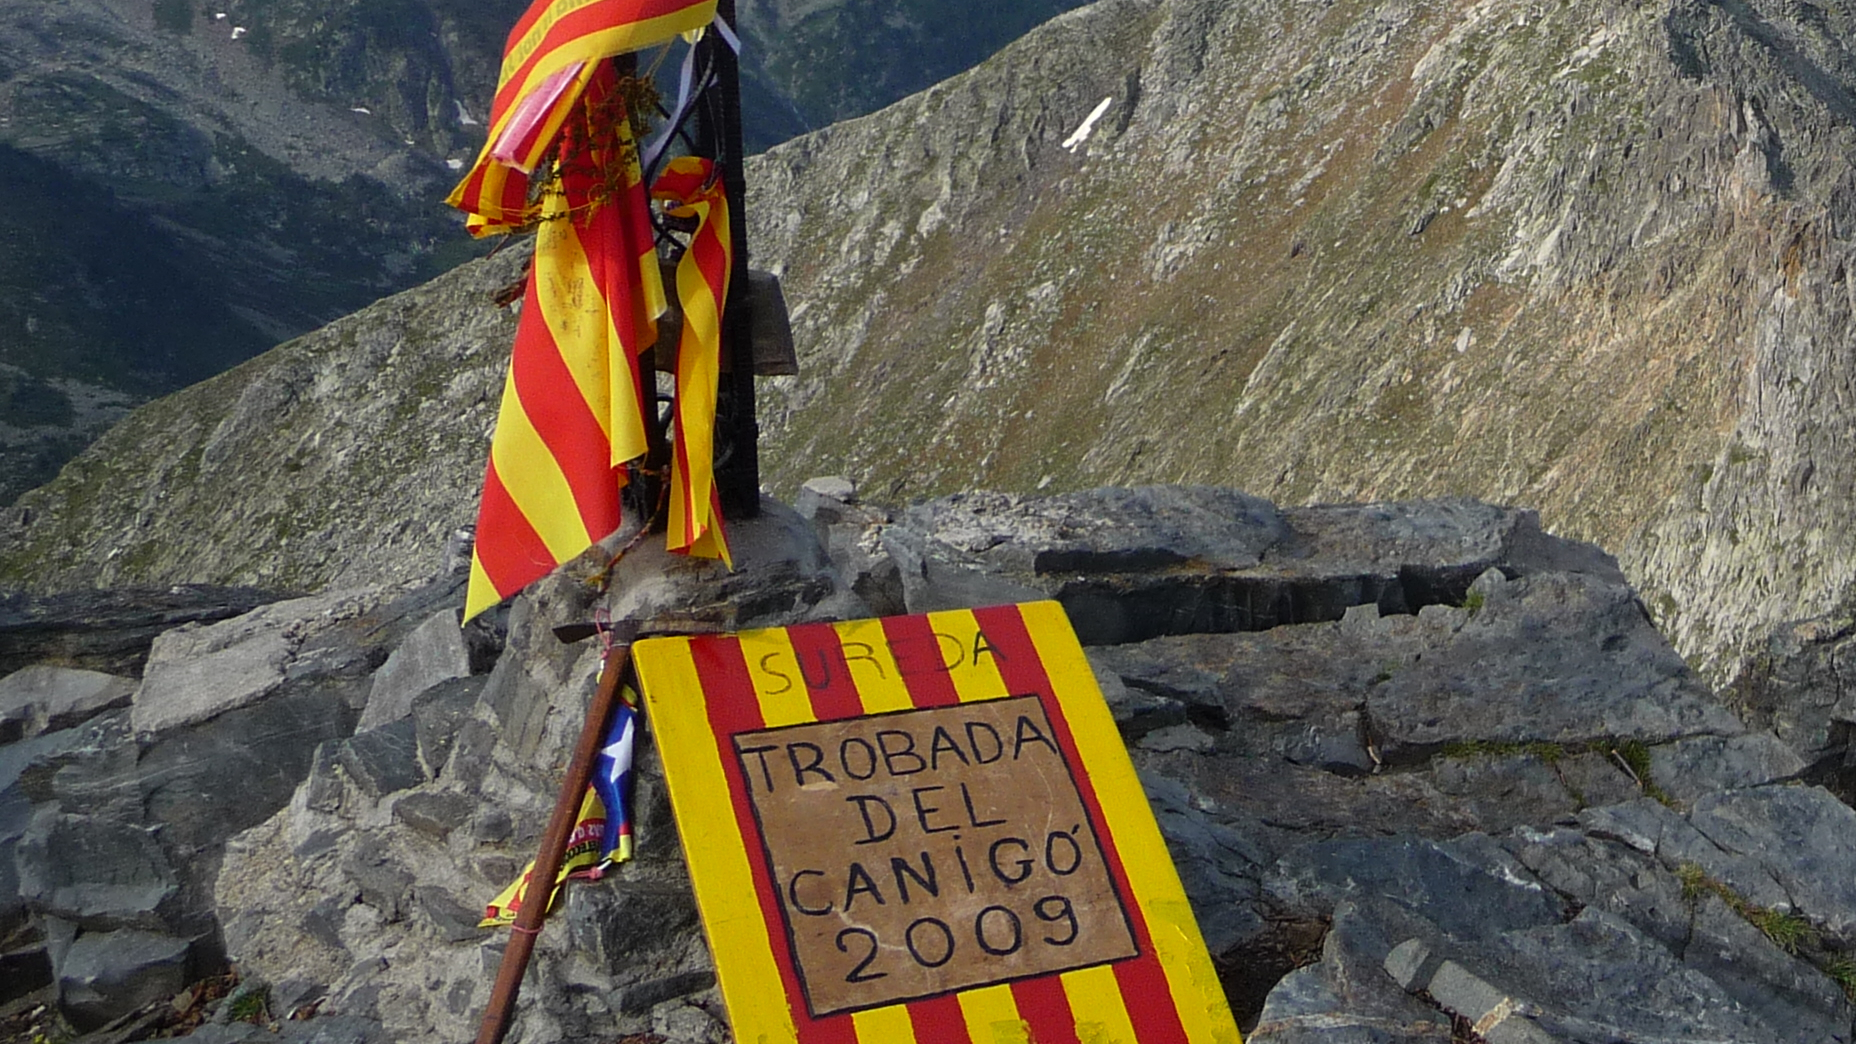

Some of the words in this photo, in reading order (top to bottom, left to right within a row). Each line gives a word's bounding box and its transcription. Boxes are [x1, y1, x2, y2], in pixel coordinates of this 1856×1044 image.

[742, 715, 1058, 793] TROBADA
[847, 782, 1007, 845] DEL
[836, 895, 1080, 983] 2009
